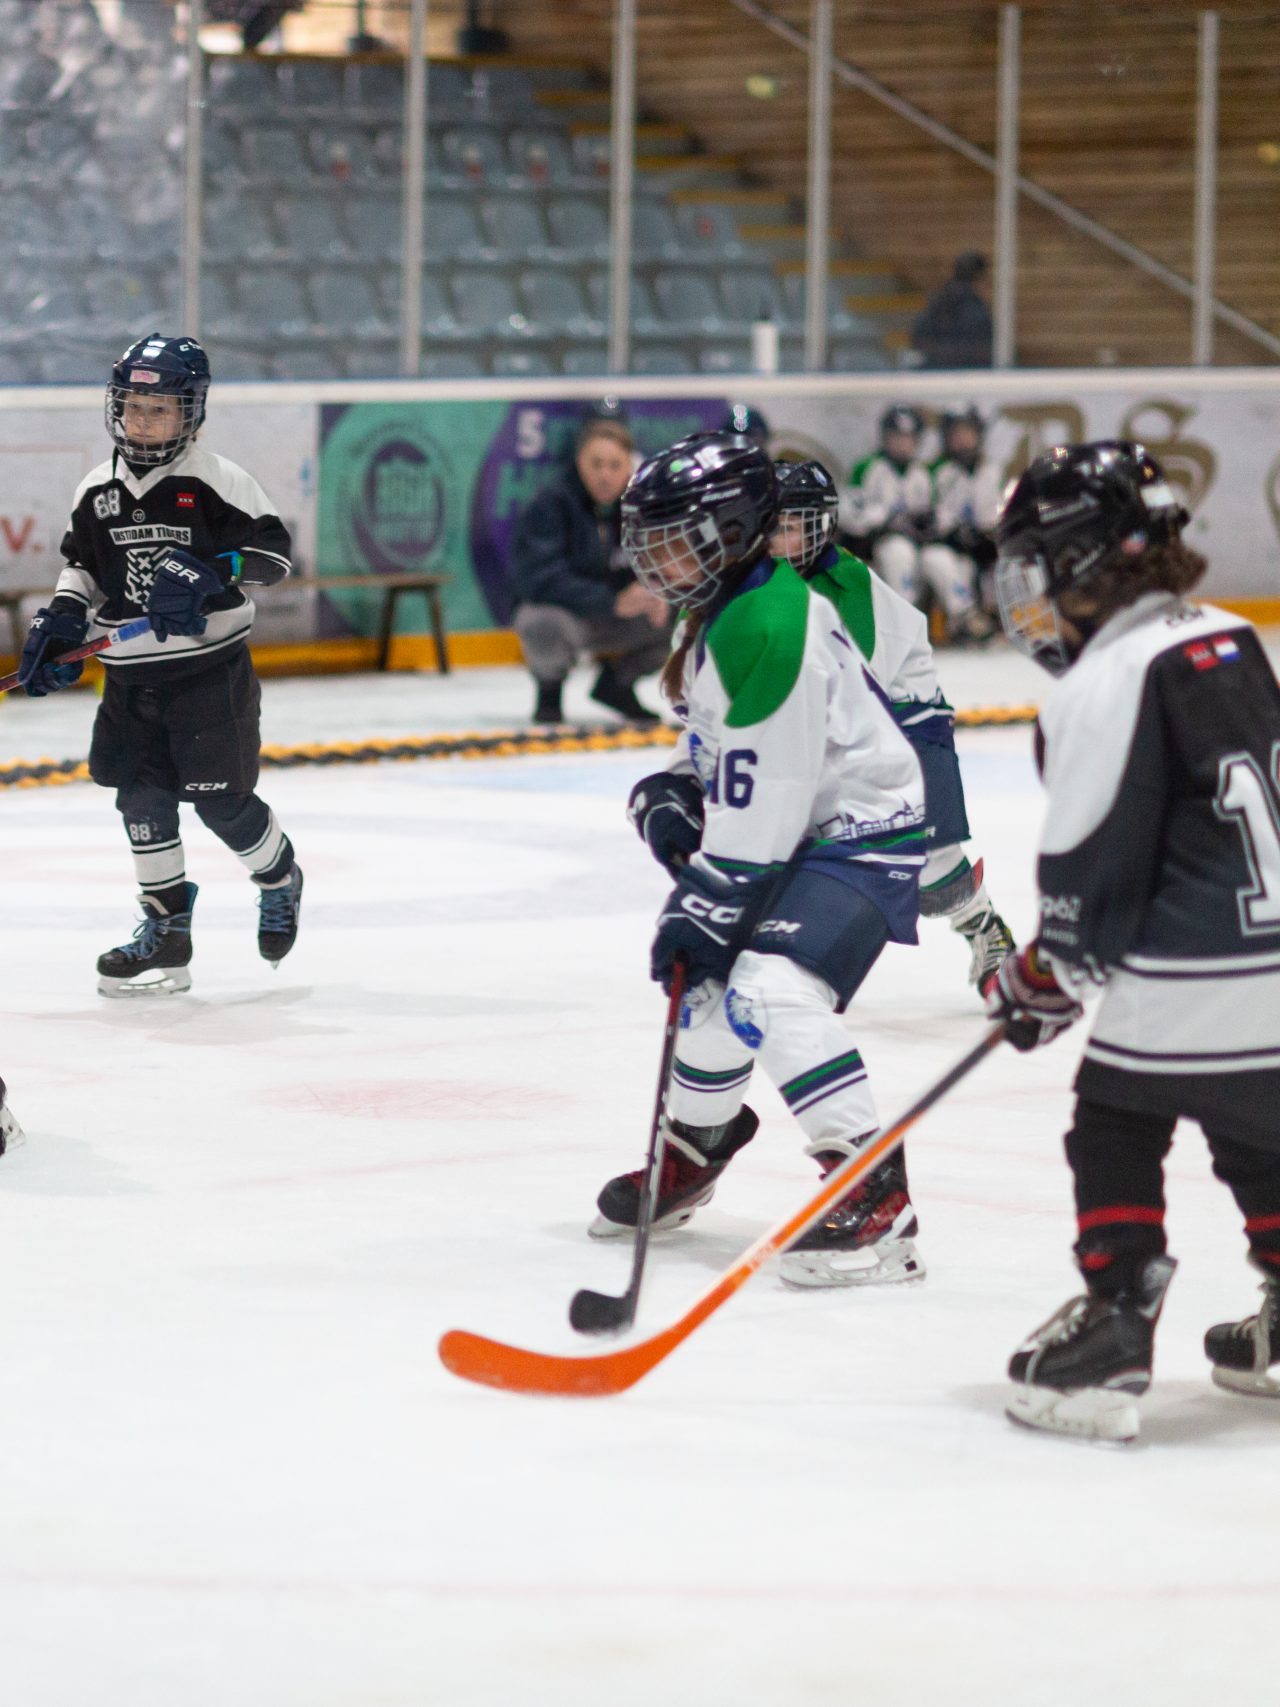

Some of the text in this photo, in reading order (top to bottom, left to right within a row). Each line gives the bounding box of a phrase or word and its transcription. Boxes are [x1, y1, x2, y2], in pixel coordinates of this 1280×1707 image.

[93, 487, 121, 520] 88
[184, 781, 229, 792] CCM
[129, 823, 151, 841] 88
[1212, 740, 1280, 938] 1
